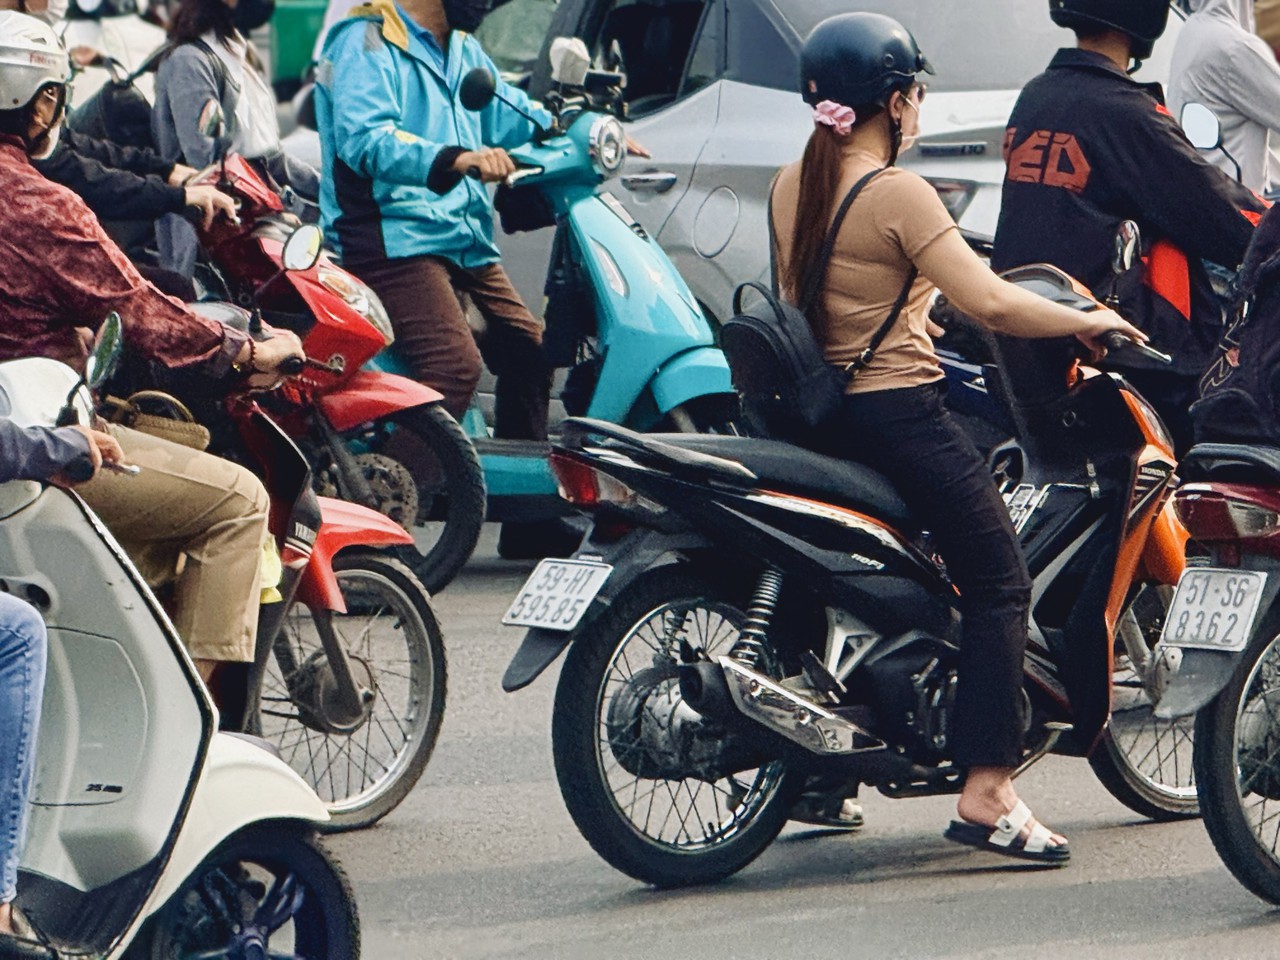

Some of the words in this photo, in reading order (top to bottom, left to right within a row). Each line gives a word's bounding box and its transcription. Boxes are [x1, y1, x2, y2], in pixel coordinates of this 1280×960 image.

[536, 565, 595, 595] 59-H1
[511, 593, 585, 624] 595.85
[1174, 610, 1239, 644] 8362
